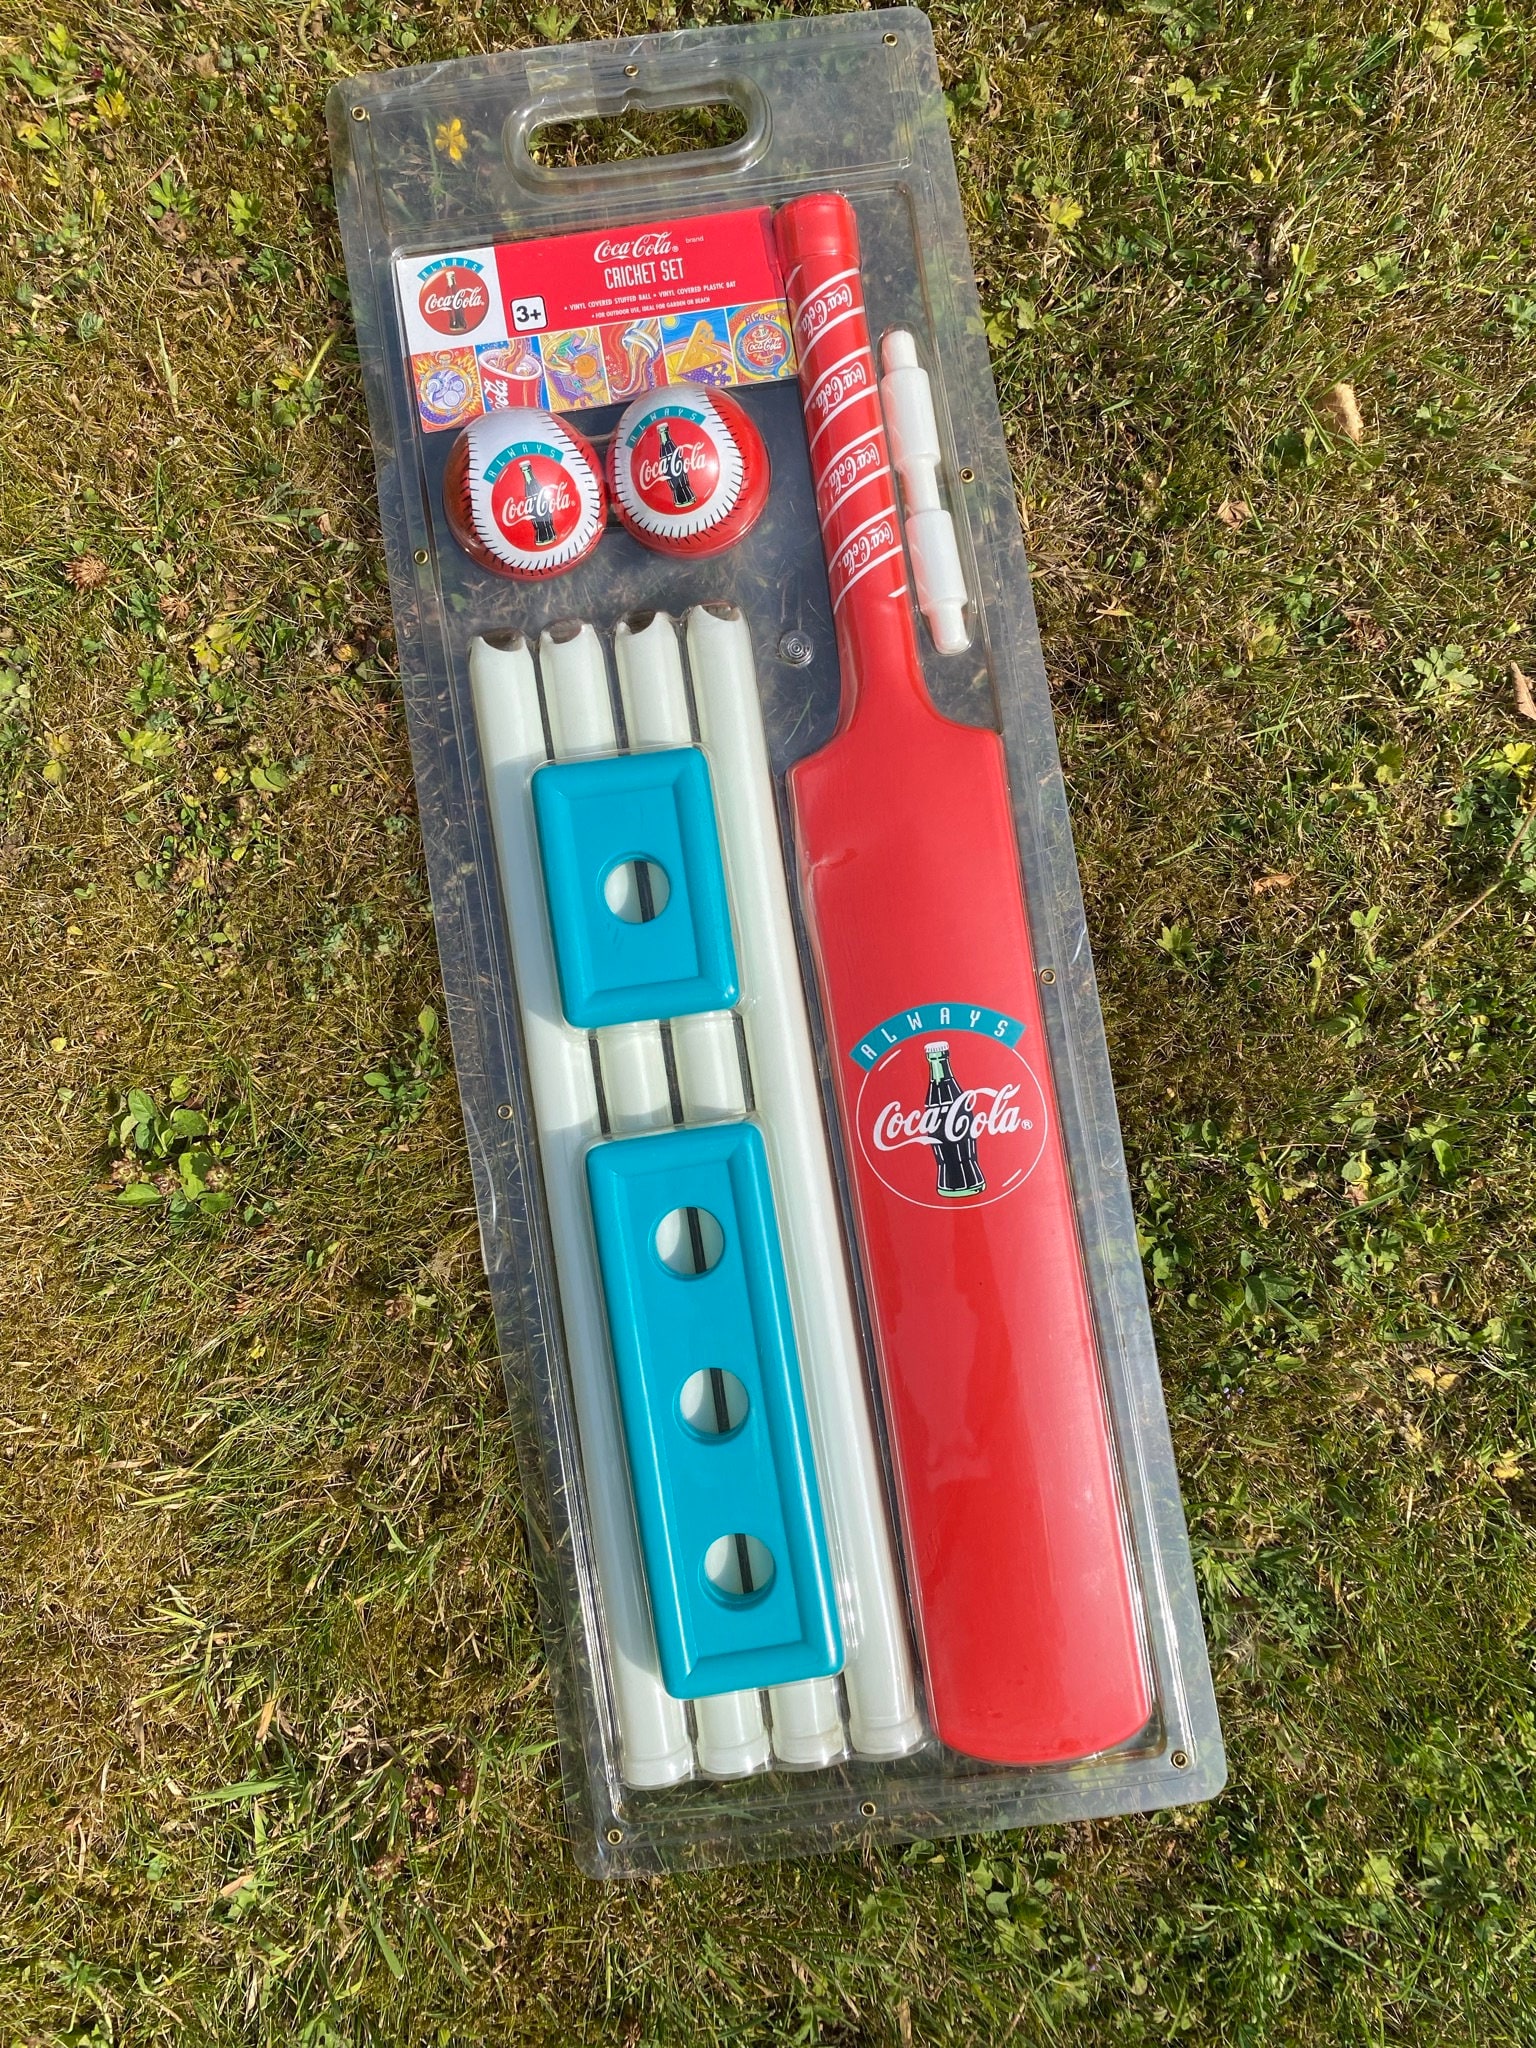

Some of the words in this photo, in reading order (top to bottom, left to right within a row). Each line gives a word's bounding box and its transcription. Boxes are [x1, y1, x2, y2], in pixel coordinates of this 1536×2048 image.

[685, 235, 704, 243] brand
[421, 258, 479, 279] ALWAYS
[604, 262, 657, 289] CRICKET
[660, 257, 684, 281] SET
[569, 302, 586, 311] VINYL
[588, 298, 613, 308] COVERED
[614, 295, 637, 305] STUFFED
[638, 293, 651, 301] BALL
[658, 289, 675, 298] VINYL
[677, 285, 702, 296] COVERED
[703, 282, 725, 292] PLASTIC
[725, 280, 736, 289] BAT
[595, 311, 606, 319] FOR
[606, 308, 630, 317] OUTDOOR
[641, 303, 655, 312] IDEAL
[656, 302, 666, 310] FOR
[666, 299, 686, 308] GARDEN
[694, 296, 711, 304] BEACH
[516, 306, 541, 323] 3+
[629, 403, 697, 443] ALWAYS
[487, 443, 556, 478] ALWAYS
[860, 1007, 1009, 1061] ALWAYS
